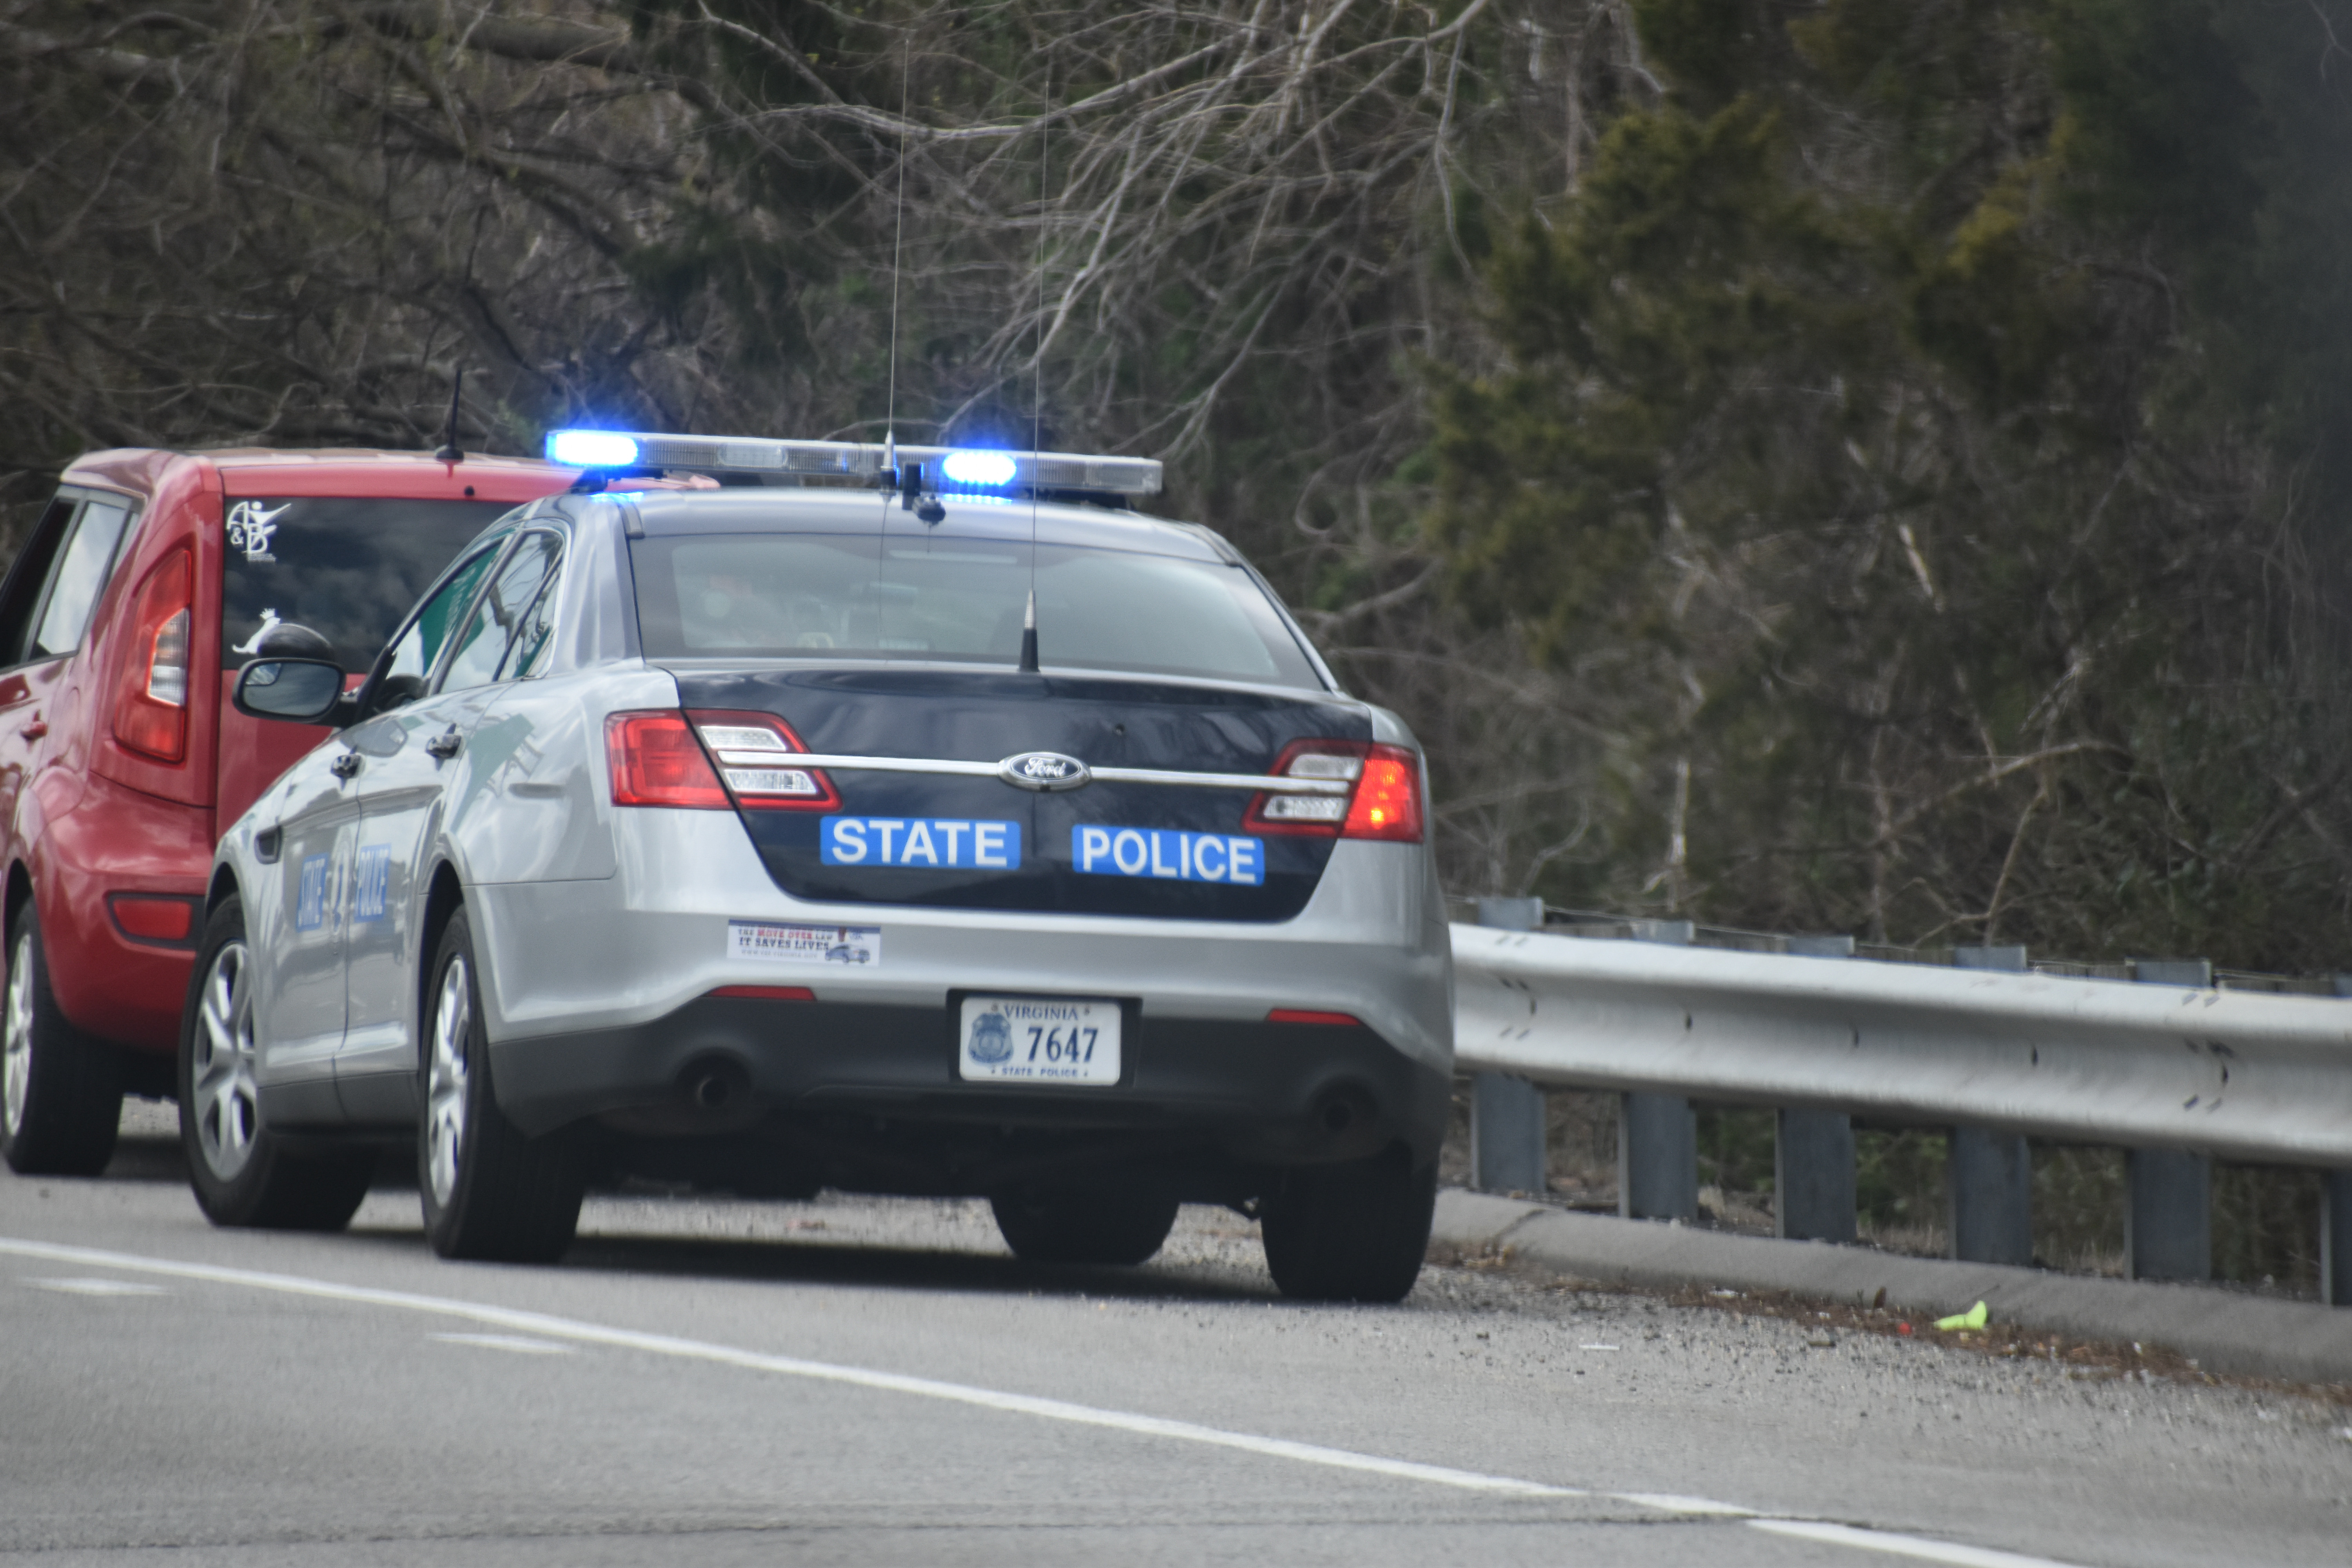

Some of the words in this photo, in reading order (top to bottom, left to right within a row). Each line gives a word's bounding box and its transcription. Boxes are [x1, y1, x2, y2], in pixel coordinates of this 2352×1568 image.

[1024, 757, 1067, 778] Ford
[832, 818, 1007, 867] STATE
[1083, 828, 1256, 884] POLICE
[298, 858, 326, 927] STATE
[357, 849, 388, 916] POLICE
[757, 929, 784, 938] MOVE
[739, 937, 751, 946] IT
[755, 938, 791, 949] SAVES
[795, 940, 829, 950] LIVES
[1004, 1005, 1079, 1020] VIRGINIA
[1027, 1026, 1098, 1063] 7647
[1002, 1067, 1033, 1076] STATE
[1040, 1067, 1078, 1078] POLICE
